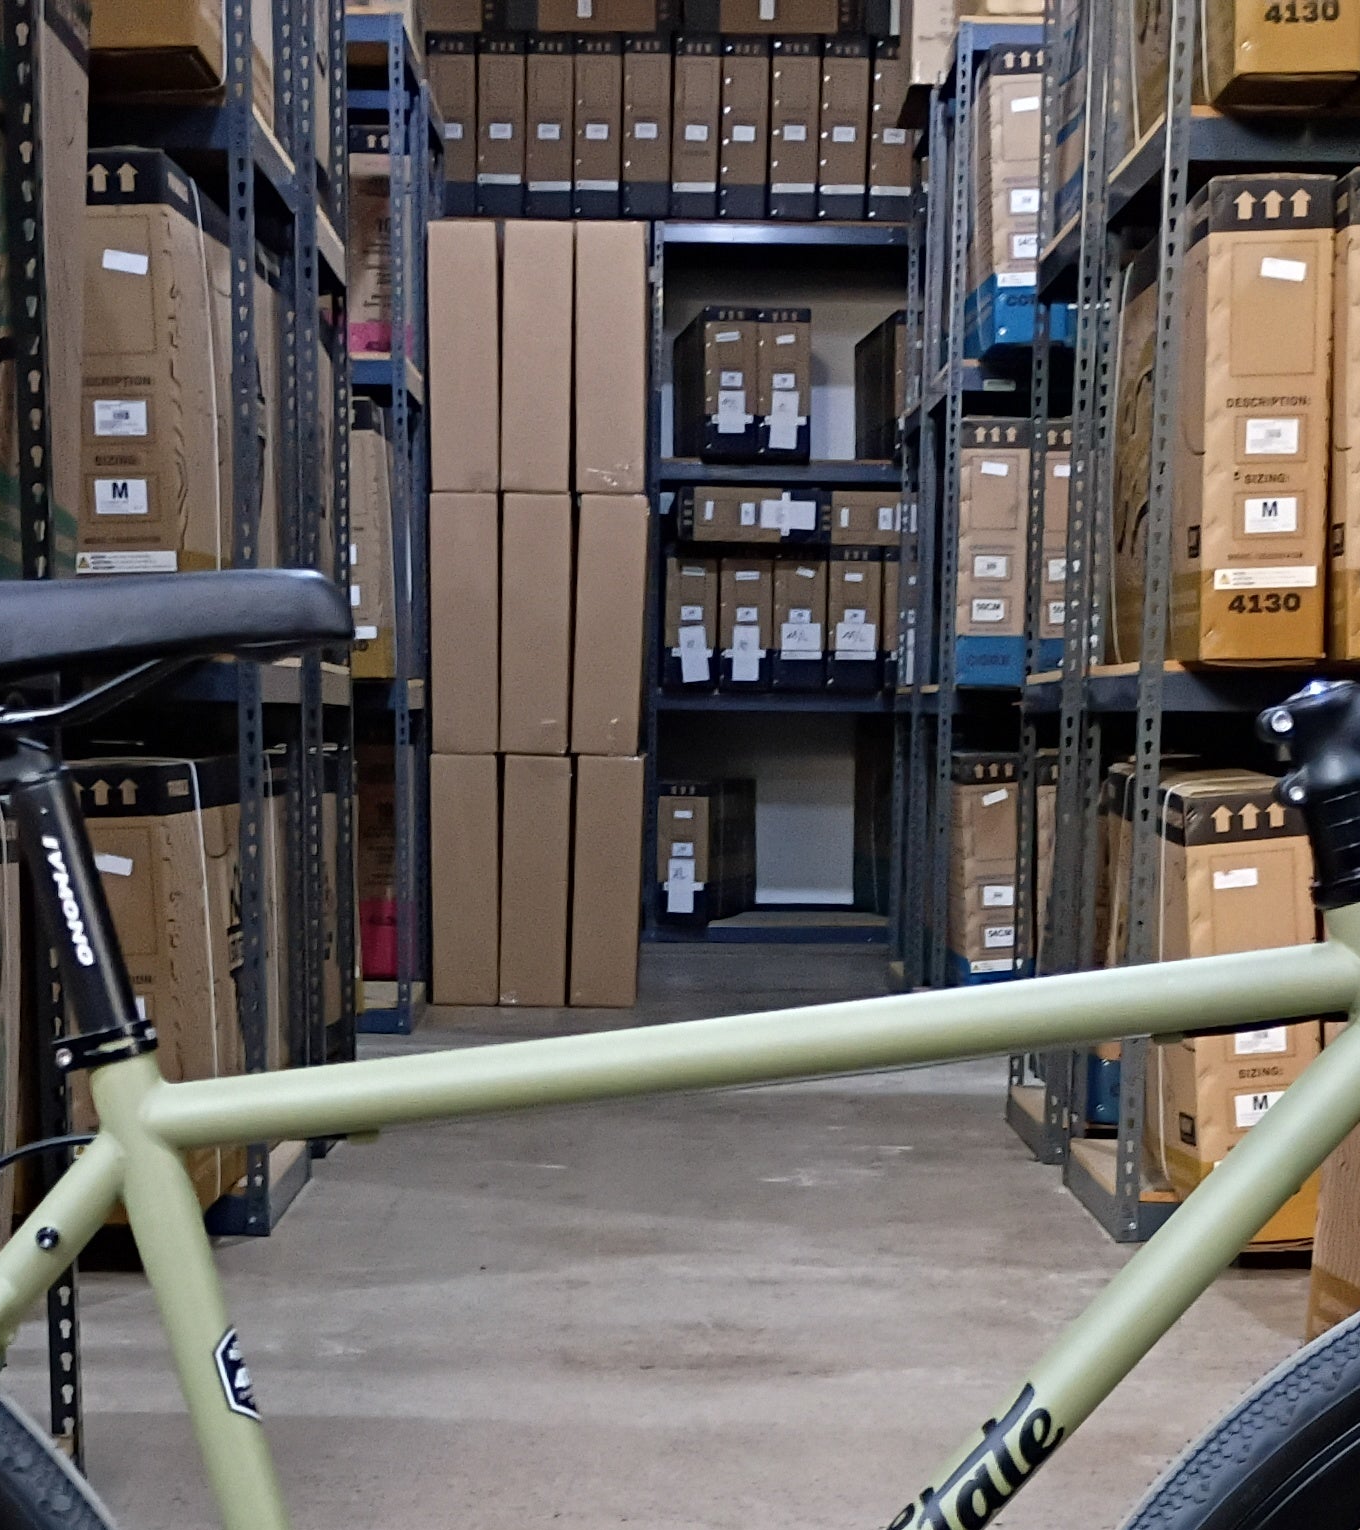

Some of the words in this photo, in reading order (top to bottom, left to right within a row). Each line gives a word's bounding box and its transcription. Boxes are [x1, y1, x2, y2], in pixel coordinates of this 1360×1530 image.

[112, 481, 130, 499] M
[1261, 500, 1279, 518] M
[1228, 592, 1301, 613] 4130
[1253, 1094, 1269, 1111] M
